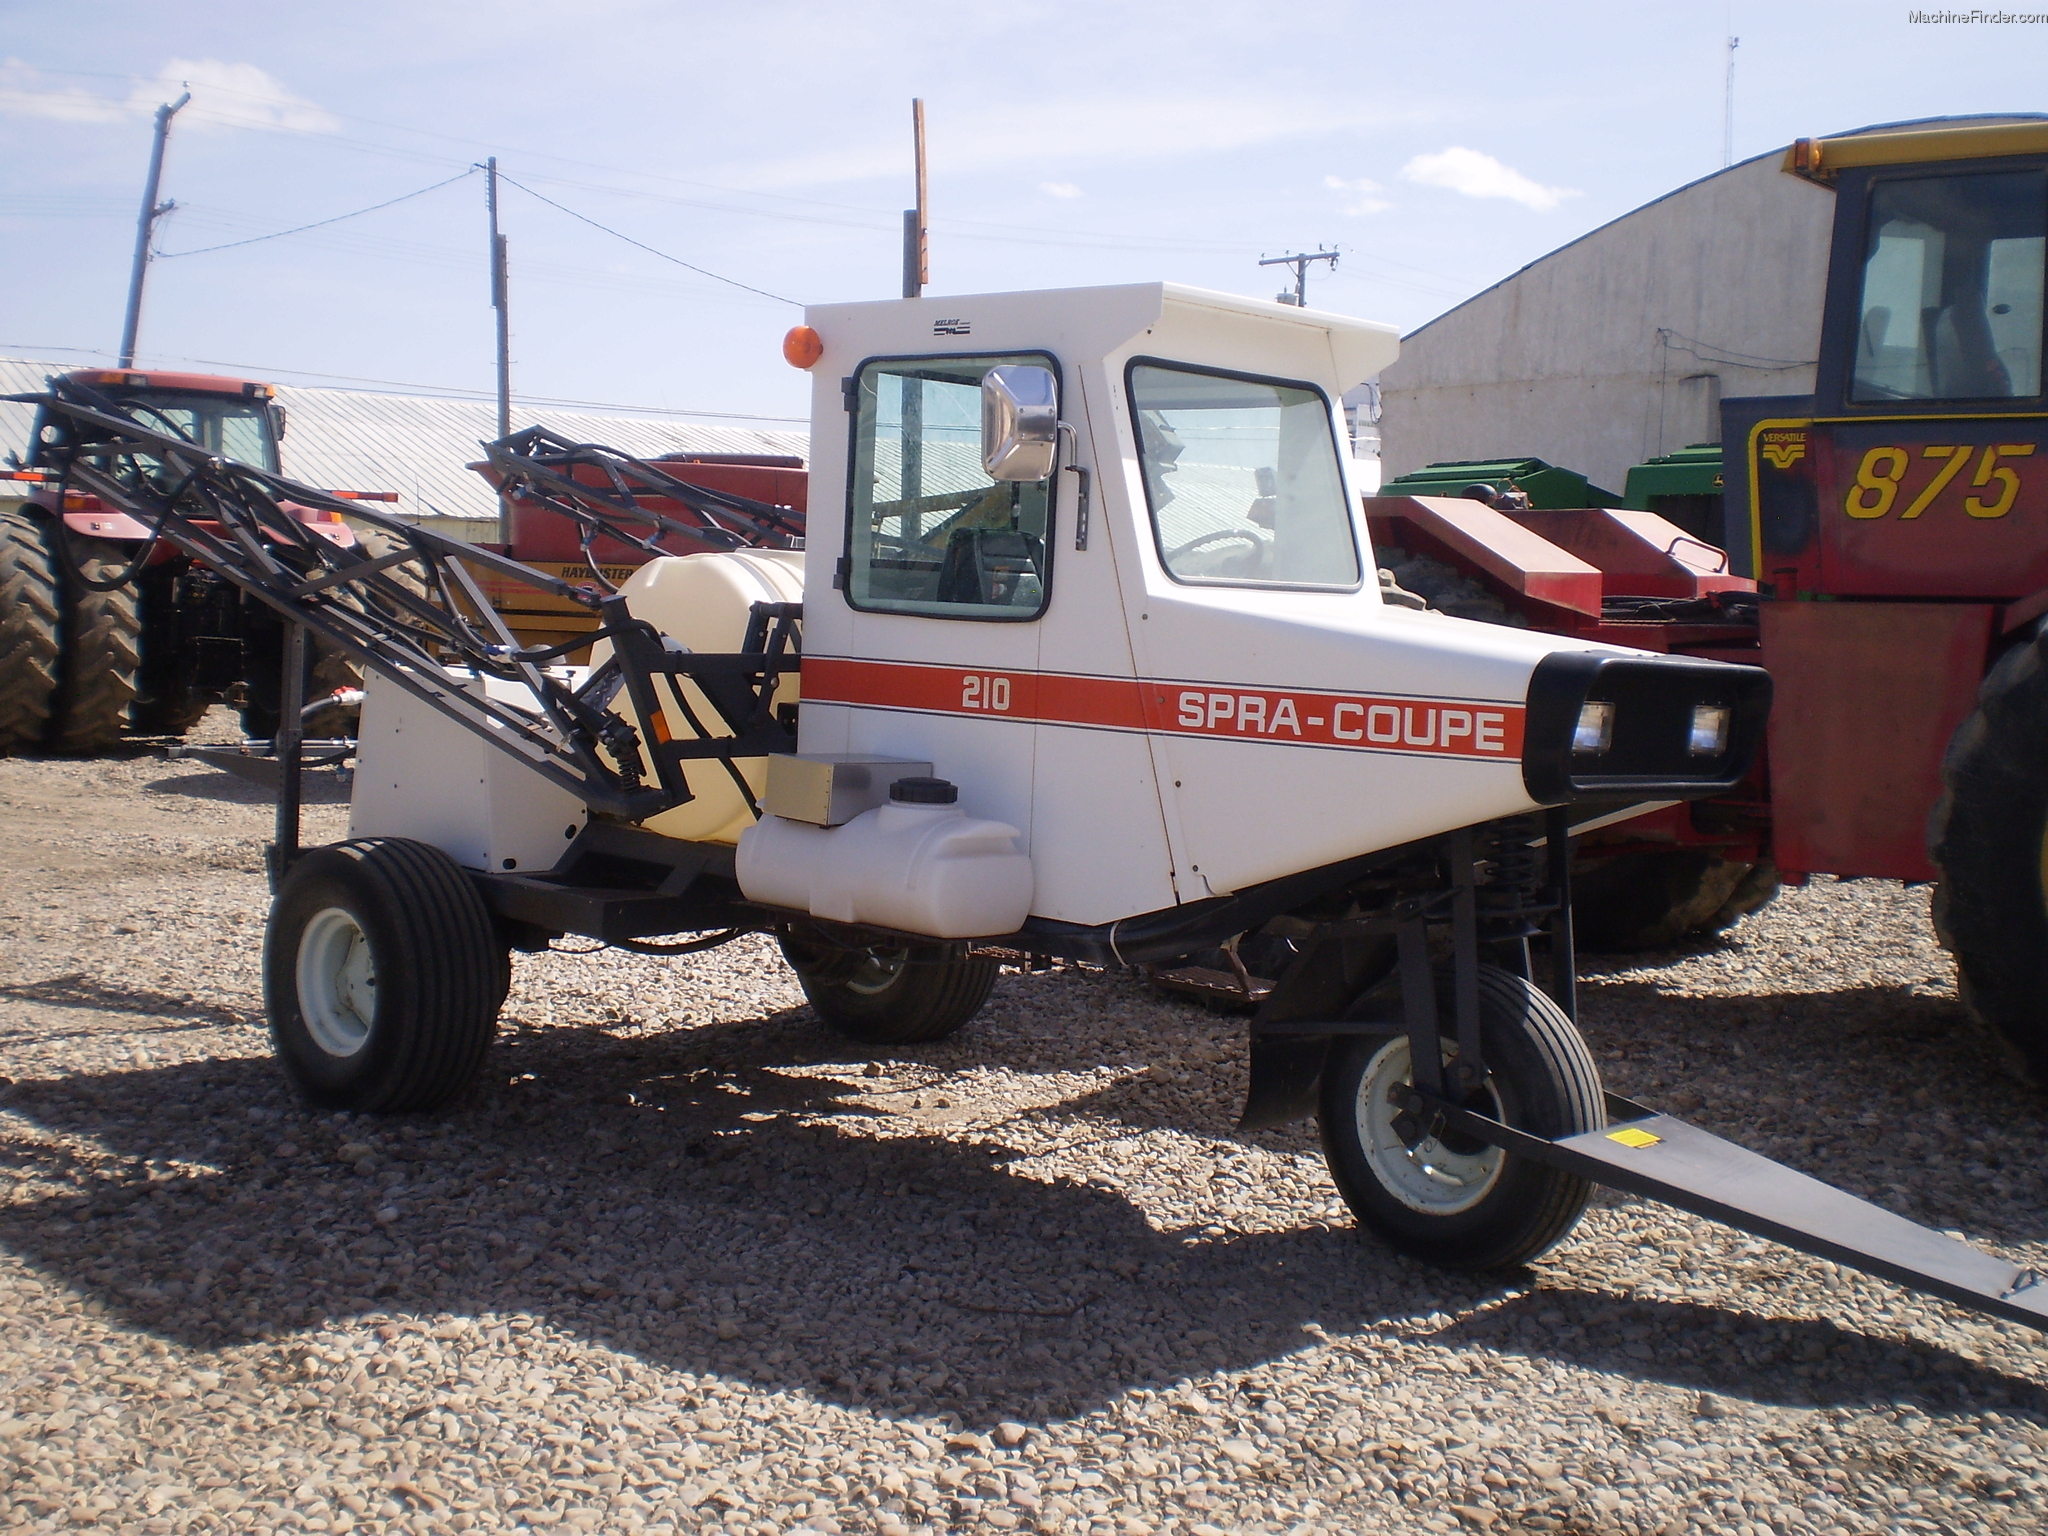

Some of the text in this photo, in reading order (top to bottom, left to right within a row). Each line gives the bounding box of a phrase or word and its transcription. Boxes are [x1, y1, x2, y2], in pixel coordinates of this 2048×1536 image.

[1763, 432, 1806, 442] VERSATILE
[1844, 443, 2037, 521] 875
[962, 675, 1010, 711] 210
[1178, 691, 1505, 751] SPRA-COUPE
